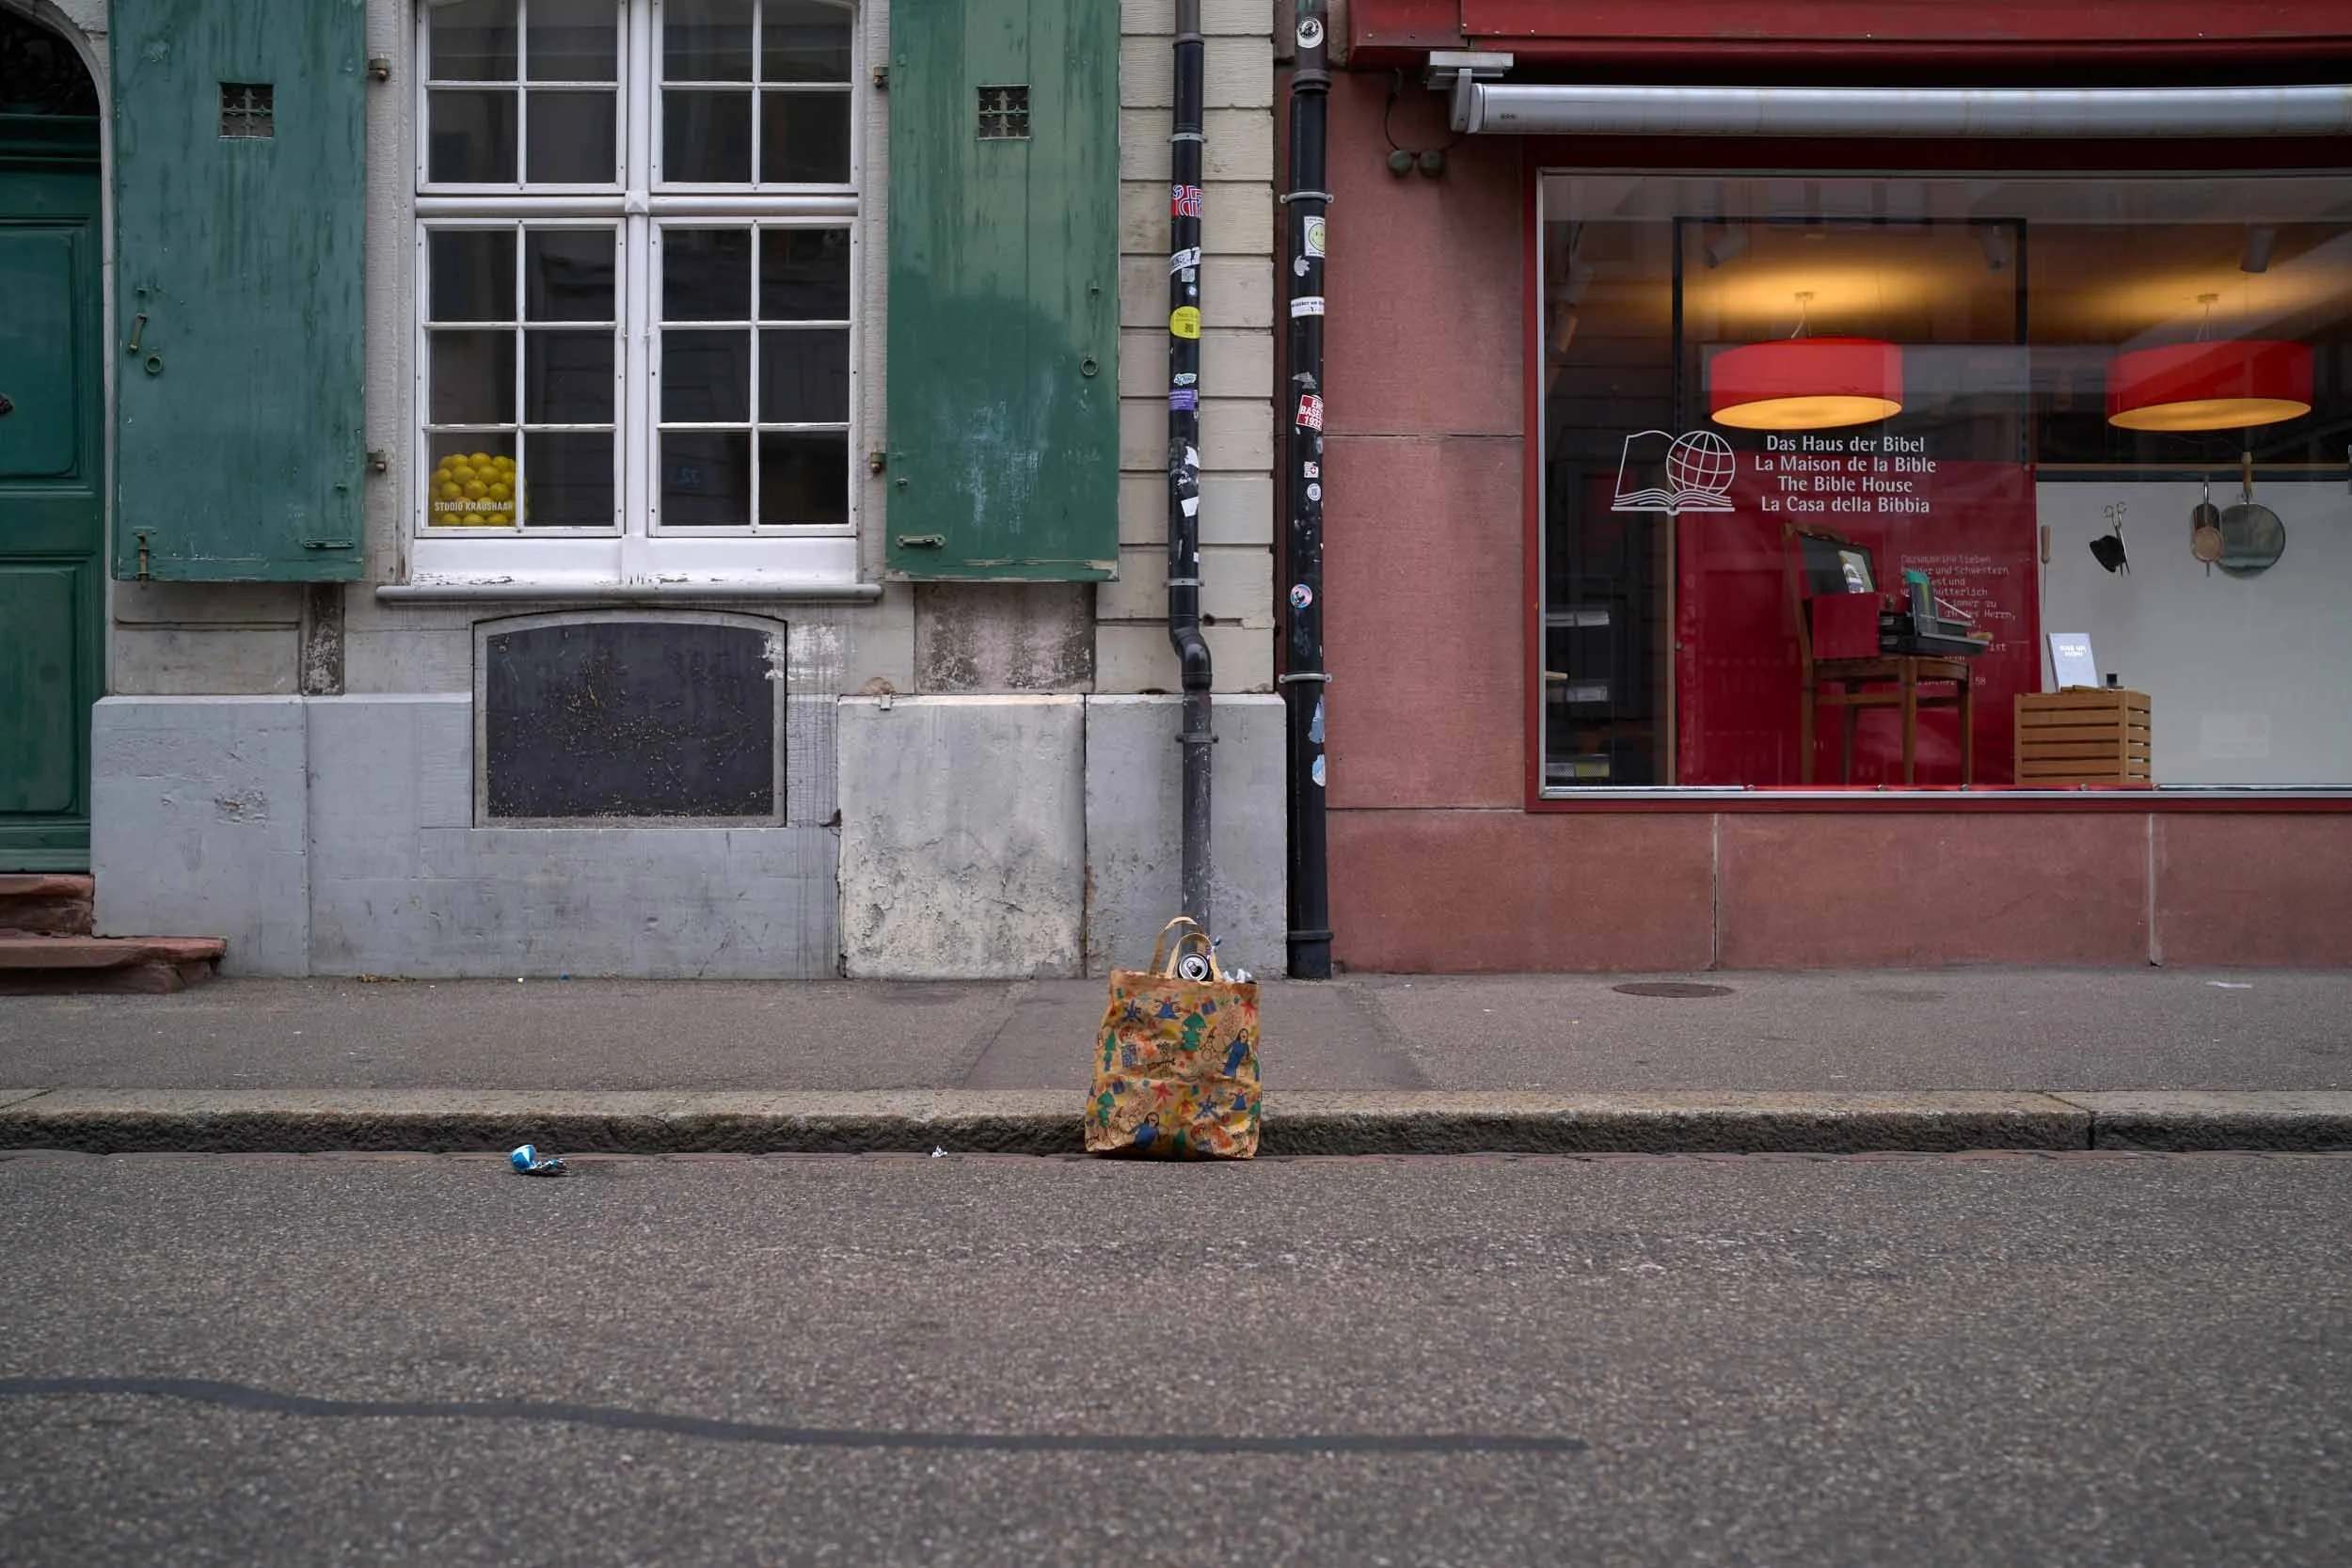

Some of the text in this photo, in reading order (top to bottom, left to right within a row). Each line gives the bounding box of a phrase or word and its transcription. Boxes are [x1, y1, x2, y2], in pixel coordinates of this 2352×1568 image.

[1766, 435, 1925, 452] Das Haus der Bibel
[1755, 455, 1937, 473] La Maison de la Bible
[1777, 476, 1914, 493] The Bible House
[435, 501, 463, 512] STUDIO
[1761, 497, 1930, 514] La Casa della Bibbia
[1935, 566, 1952, 575] und
[1948, 577, 1966, 586] und
